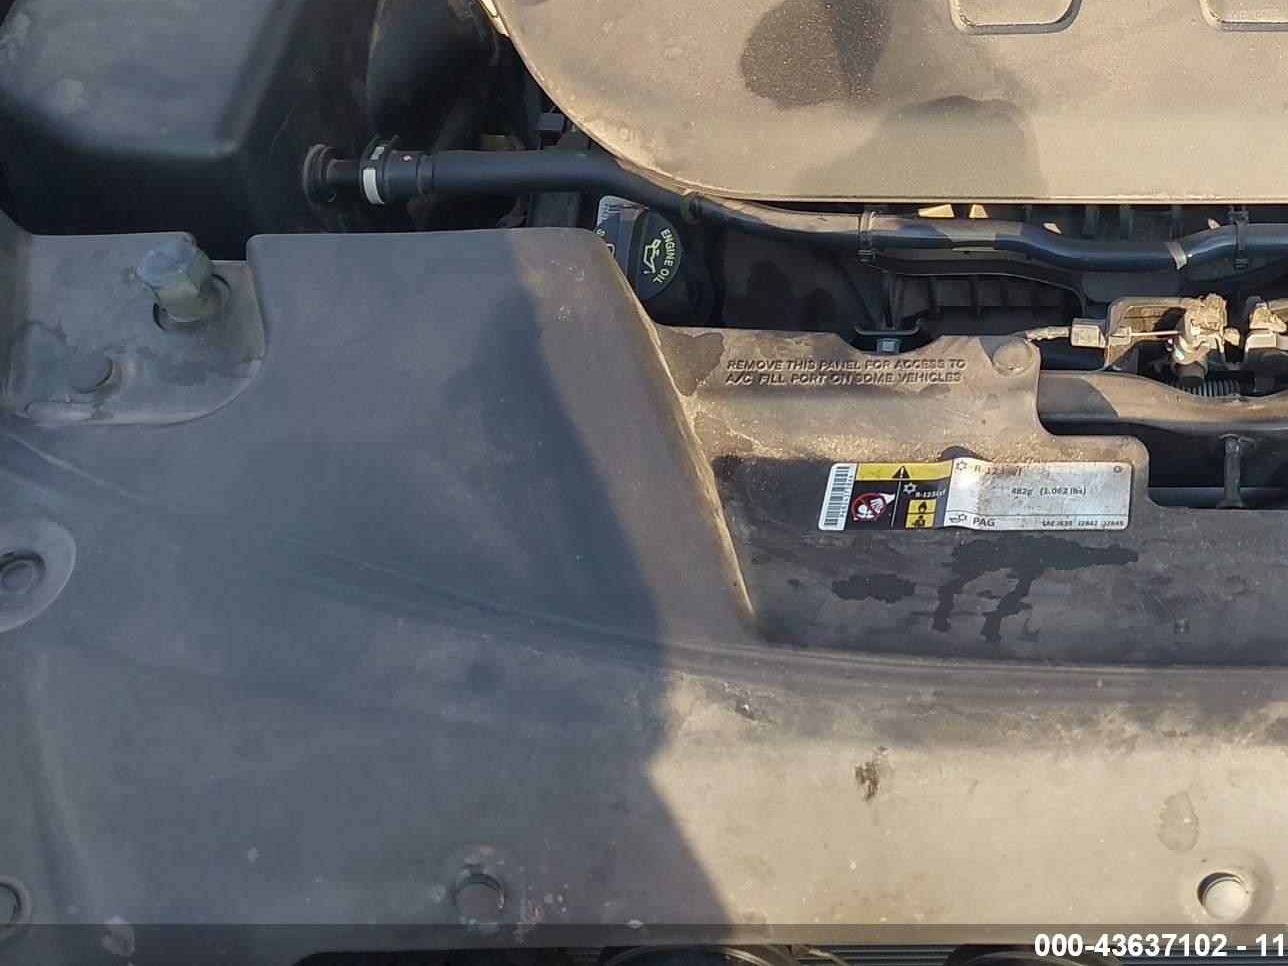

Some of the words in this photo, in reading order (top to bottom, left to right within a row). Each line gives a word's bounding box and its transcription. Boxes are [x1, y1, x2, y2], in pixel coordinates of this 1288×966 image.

[660, 228, 676, 267] ENGINE
[652, 268, 670, 284] OIL
[727, 359, 785, 371] REMOVE
[785, 359, 817, 371] THIS
[819, 359, 861, 371] PANEL
[864, 359, 891, 370] FOR
[894, 358, 946, 370] ACCESS
[949, 358, 967, 370] TO
[725, 372, 753, 386] A/C
[758, 372, 787, 386] FILL
[790, 372, 828, 386] PORT
[830, 372, 853, 385] ON
[855, 372, 895, 385] SOME
[898, 371, 963, 384] VEHICLES
[1010, 487, 1034, 497] 482g
[1040, 486, 1068, 497] (1.062
[1070, 485, 1087, 497] lbs)
[972, 516, 996, 527] PAG
